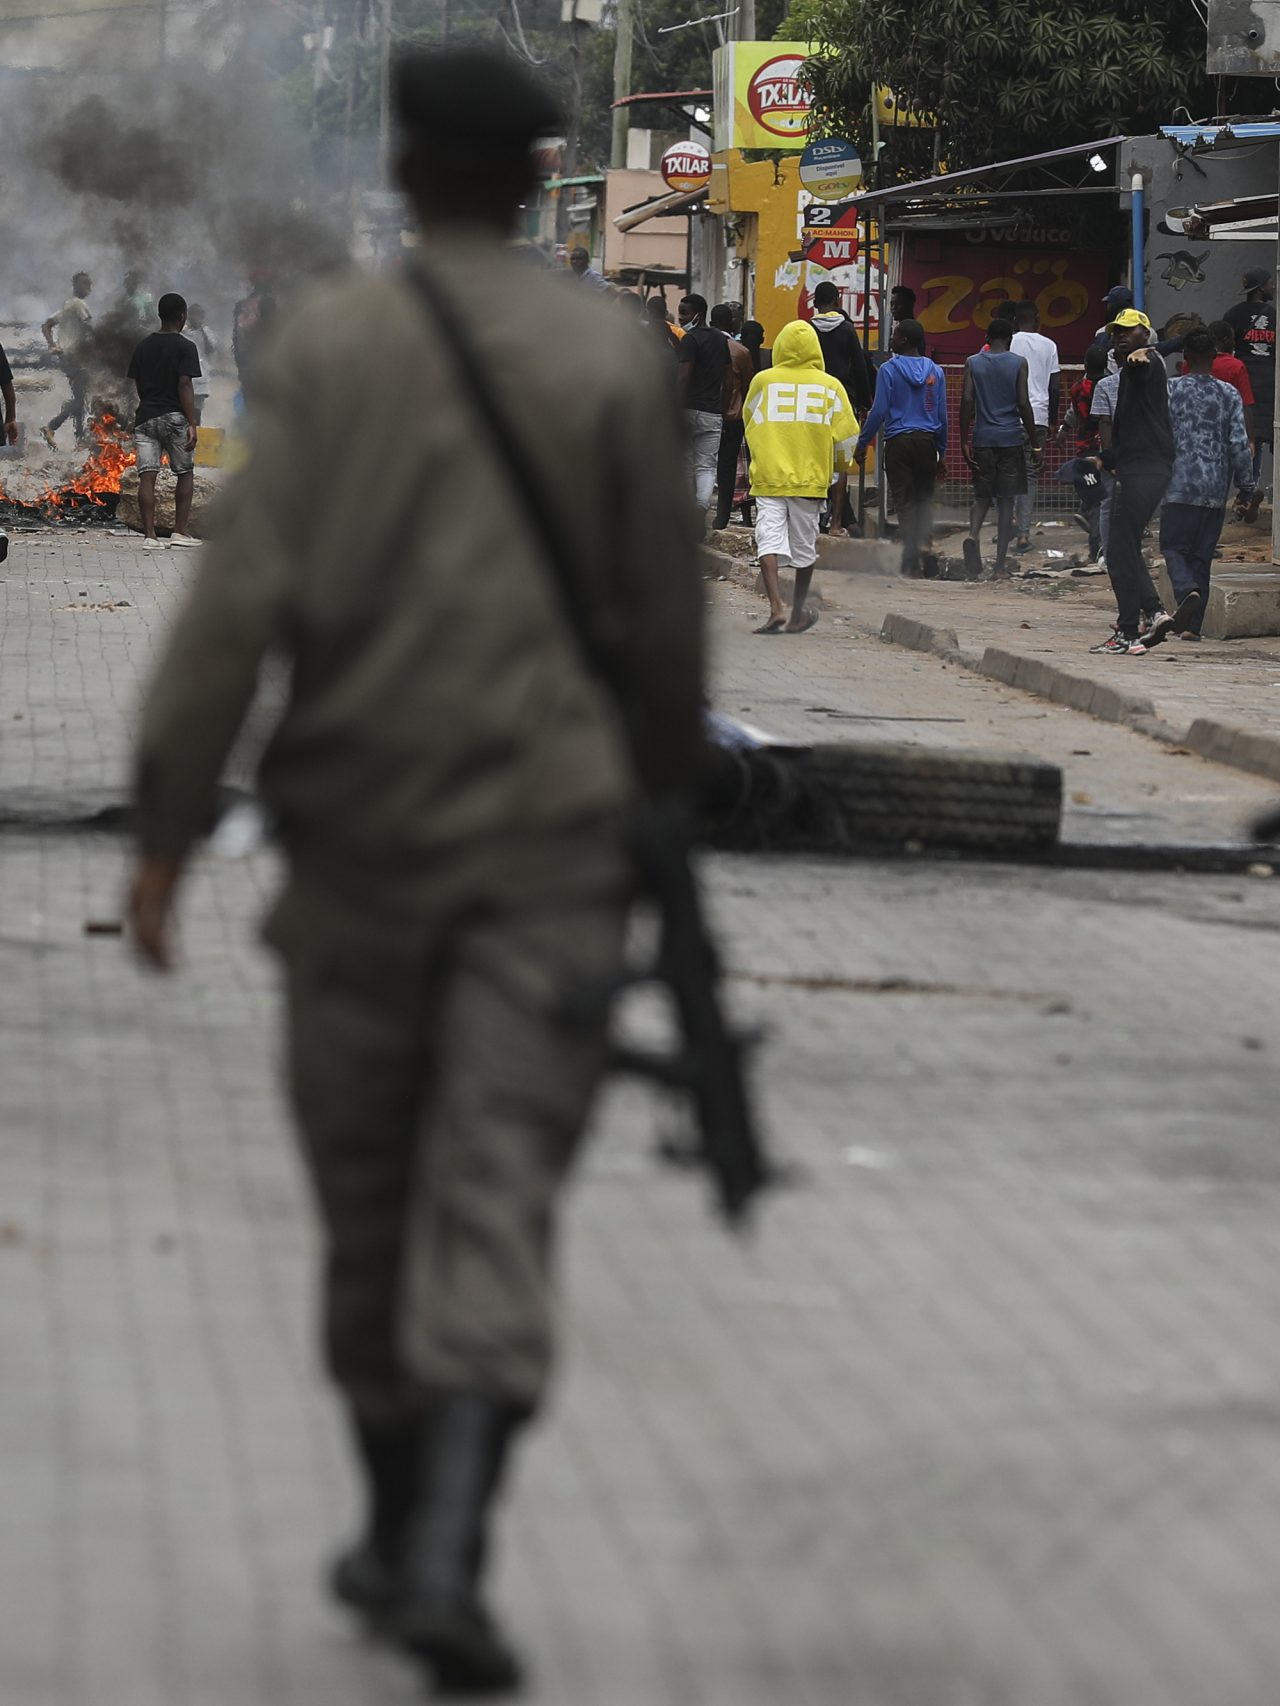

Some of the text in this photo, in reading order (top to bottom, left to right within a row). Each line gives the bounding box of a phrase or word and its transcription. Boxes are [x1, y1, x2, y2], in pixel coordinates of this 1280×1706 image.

[757, 83, 817, 109] TXILA
[665, 156, 710, 174] TXILAR
[809, 207, 832, 225] 2
[806, 229, 854, 238] AC-MAHON
[822, 240, 851, 259] M
